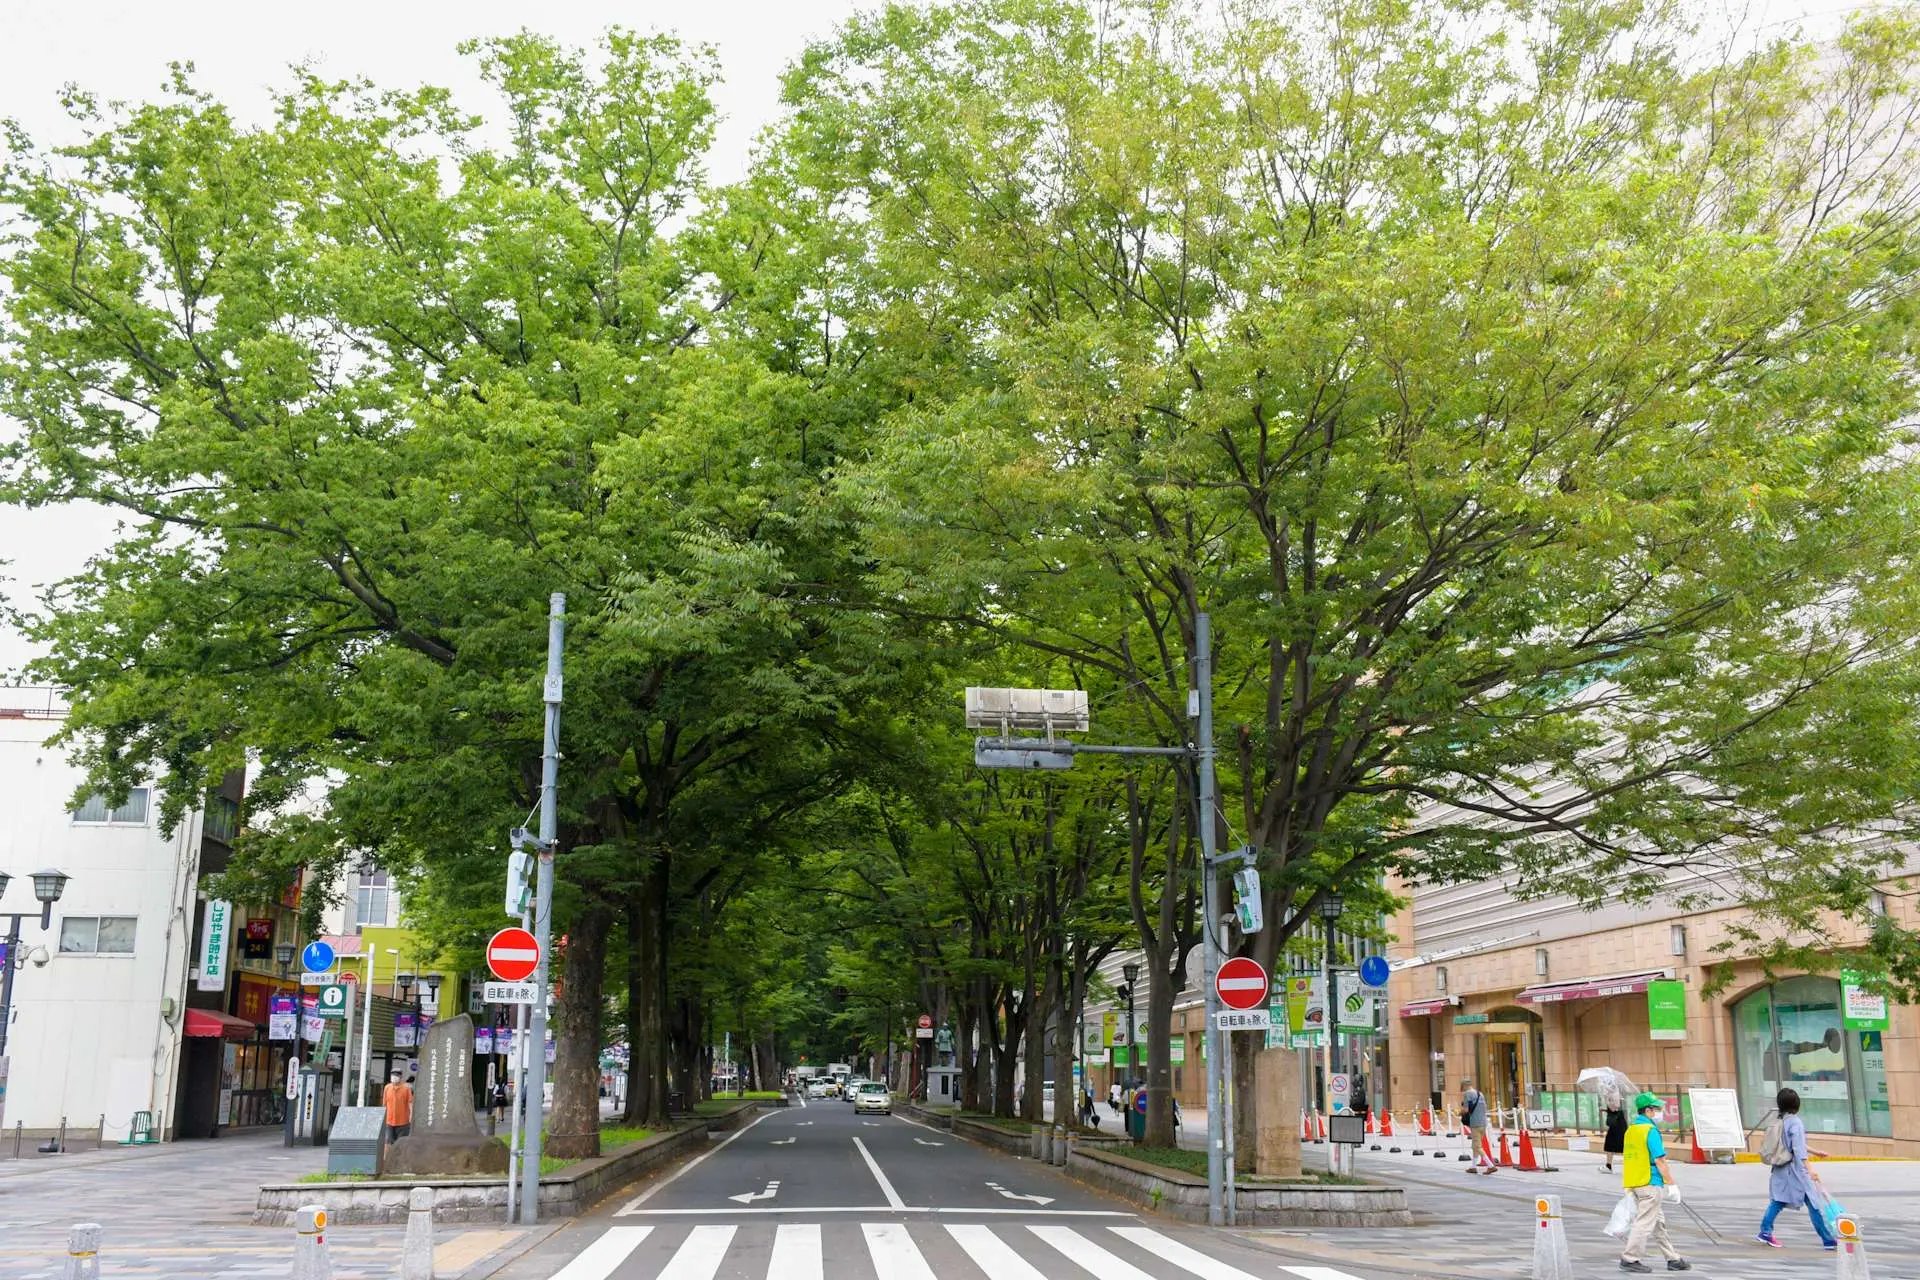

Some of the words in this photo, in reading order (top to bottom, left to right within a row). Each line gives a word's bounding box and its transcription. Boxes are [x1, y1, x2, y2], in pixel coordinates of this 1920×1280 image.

[207, 902, 224, 975] しばやま時計店
[487, 987, 535, 1000] 自転車を除く
[1220, 1014, 1267, 1026] 自転車を除く
[1532, 1114, 1551, 1125] 入口
